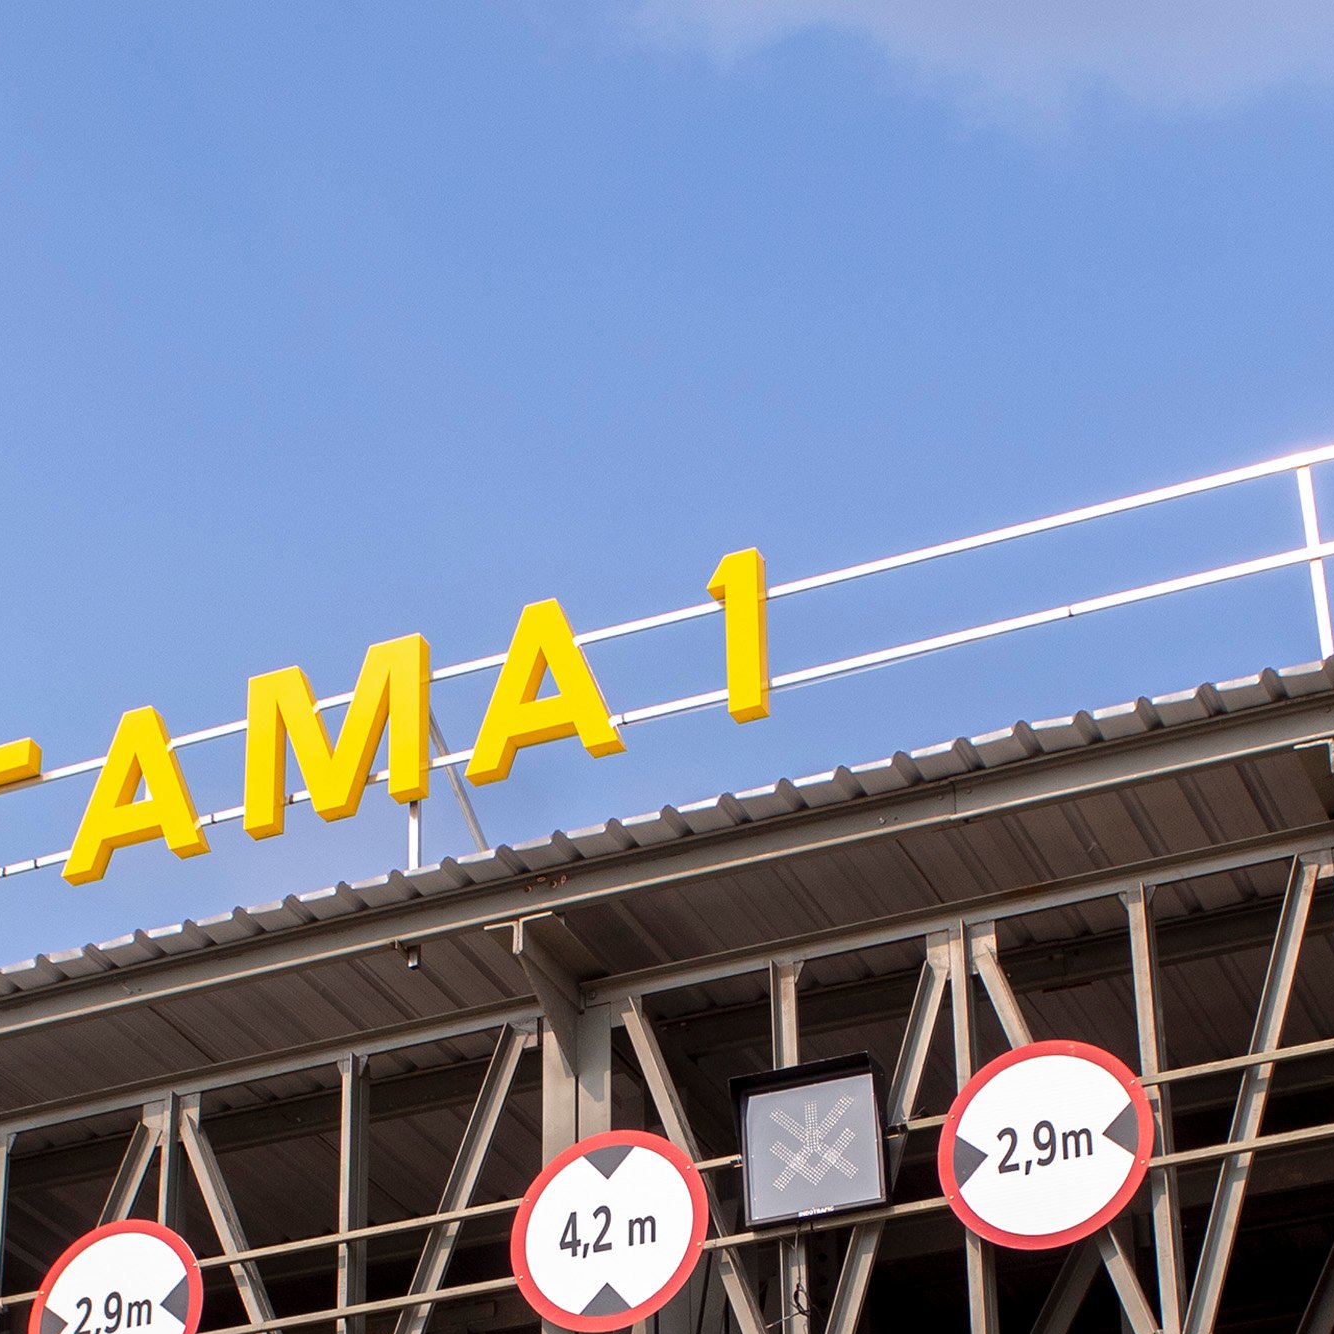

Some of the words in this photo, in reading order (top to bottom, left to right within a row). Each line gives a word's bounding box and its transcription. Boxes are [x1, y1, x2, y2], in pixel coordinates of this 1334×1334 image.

[707, 547, 770, 724] 1
[559, 1205, 613, 1259] 4,2
[628, 1215, 657, 1247] m
